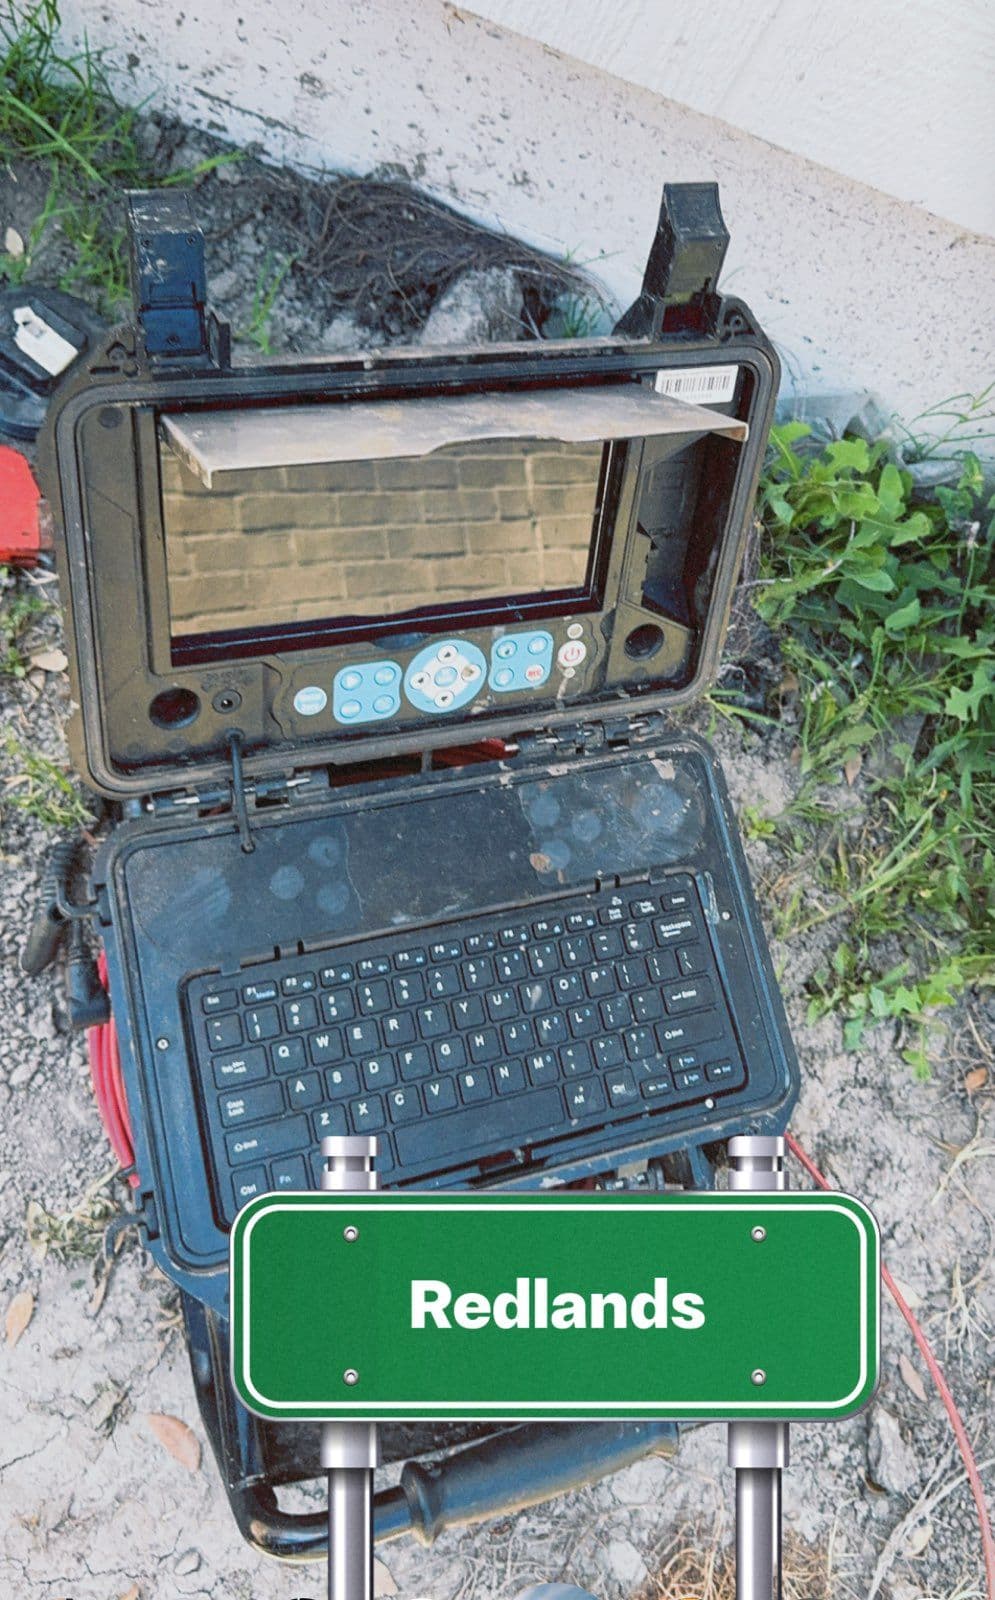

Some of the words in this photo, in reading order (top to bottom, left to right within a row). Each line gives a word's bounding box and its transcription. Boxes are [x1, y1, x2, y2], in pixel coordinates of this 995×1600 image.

[278, 1045, 290, 1058] Q
[316, 1034, 330, 1048] W
[352, 1027, 363, 1040] E
[389, 1018, 399, 1031] R
[424, 1010, 433, 1021] T
[459, 1001, 468, 1013] Y
[492, 993, 502, 1006] U
[559, 978, 569, 990] O
[590, 971, 599, 983] P
[295, 1080, 306, 1093] A
[368, 1061, 379, 1074] D
[404, 1052, 413, 1065] F
[474, 1034, 485, 1047] H
[509, 1026, 517, 1039] J
[541, 1018, 552, 1031] K
[574, 1012, 583, 1023] L
[320, 1112, 331, 1126] Z
[358, 1102, 369, 1116] X
[394, 1093, 405, 1106] C
[430, 1083, 440, 1096] V
[499, 1065, 510, 1079] N
[533, 1056, 545, 1070] M
[240, 1183, 257, 1196] Ctrl
